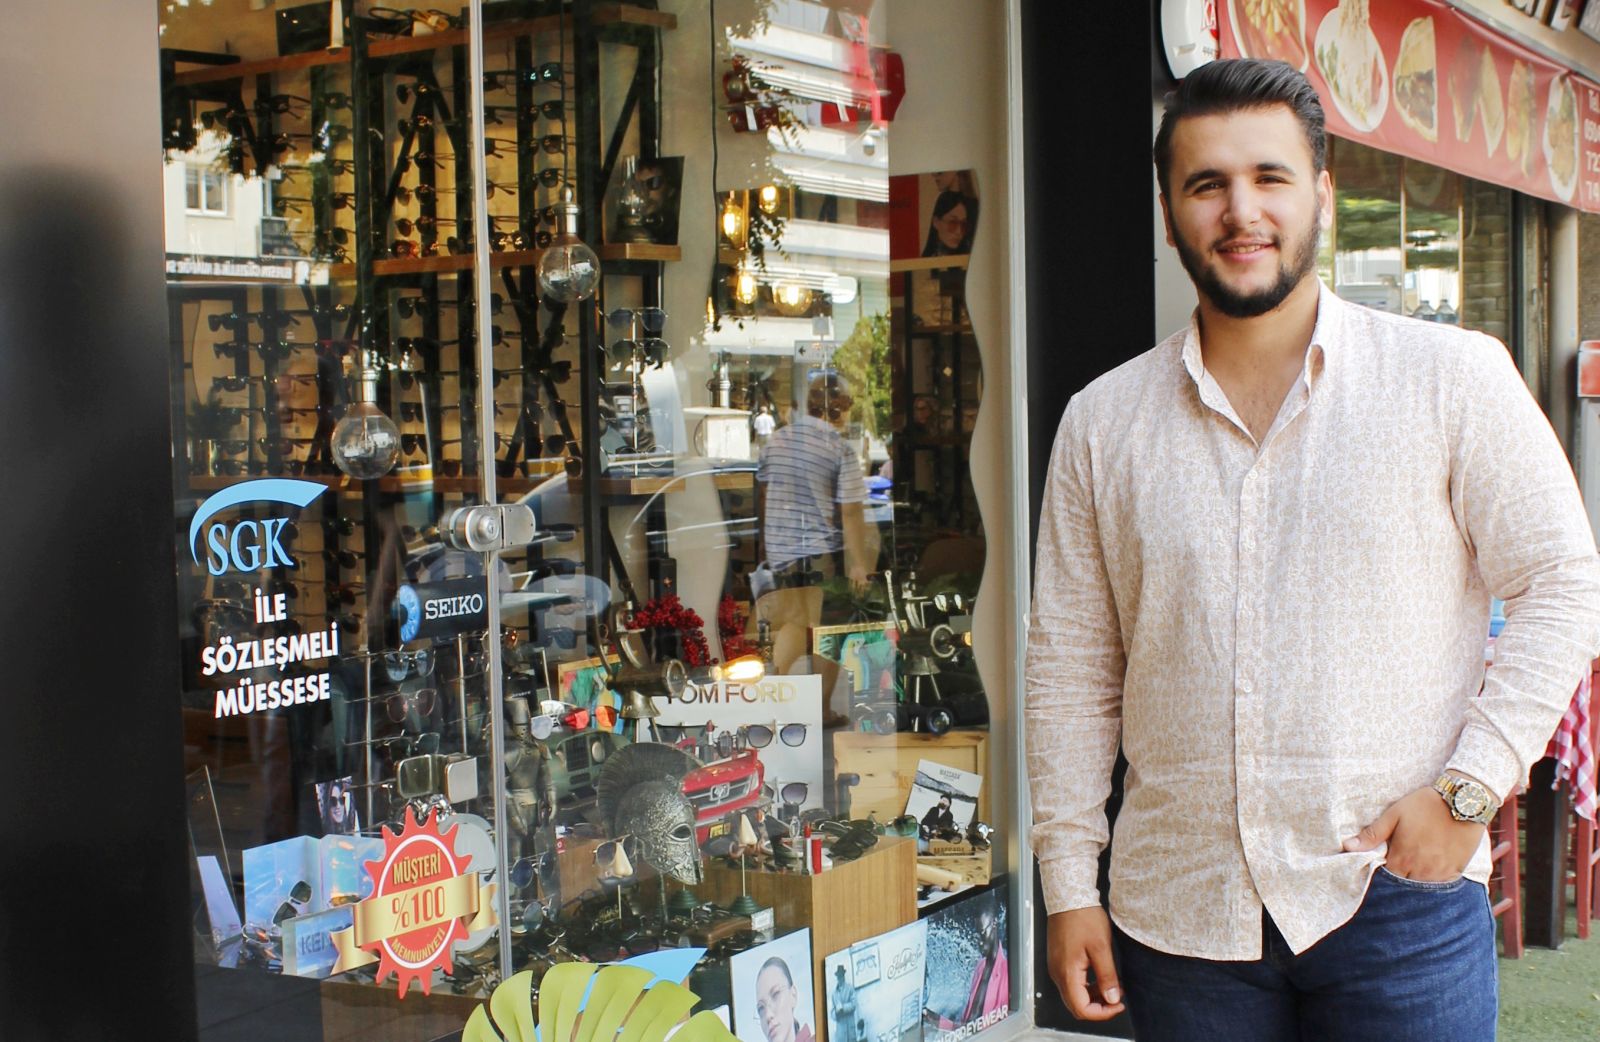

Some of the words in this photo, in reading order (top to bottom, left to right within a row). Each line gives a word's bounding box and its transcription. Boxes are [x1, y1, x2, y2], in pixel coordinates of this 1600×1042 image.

[207, 517, 294, 576] SGK
[254, 587, 287, 624] İLE
[425, 593, 483, 620] SEIKO
[202, 621, 338, 676] SÖZLEŞMELİ
[214, 673, 331, 719] MÜESSESE
[667, 682, 718, 704] OM
[725, 681, 798, 704] FORD
[392, 847, 441, 885] MÜŞTERİ
[392, 886, 446, 933] %100
[391, 927, 446, 963] MEMNUNİYETİ
[966, 1004, 1009, 1037] EYEWEAR
